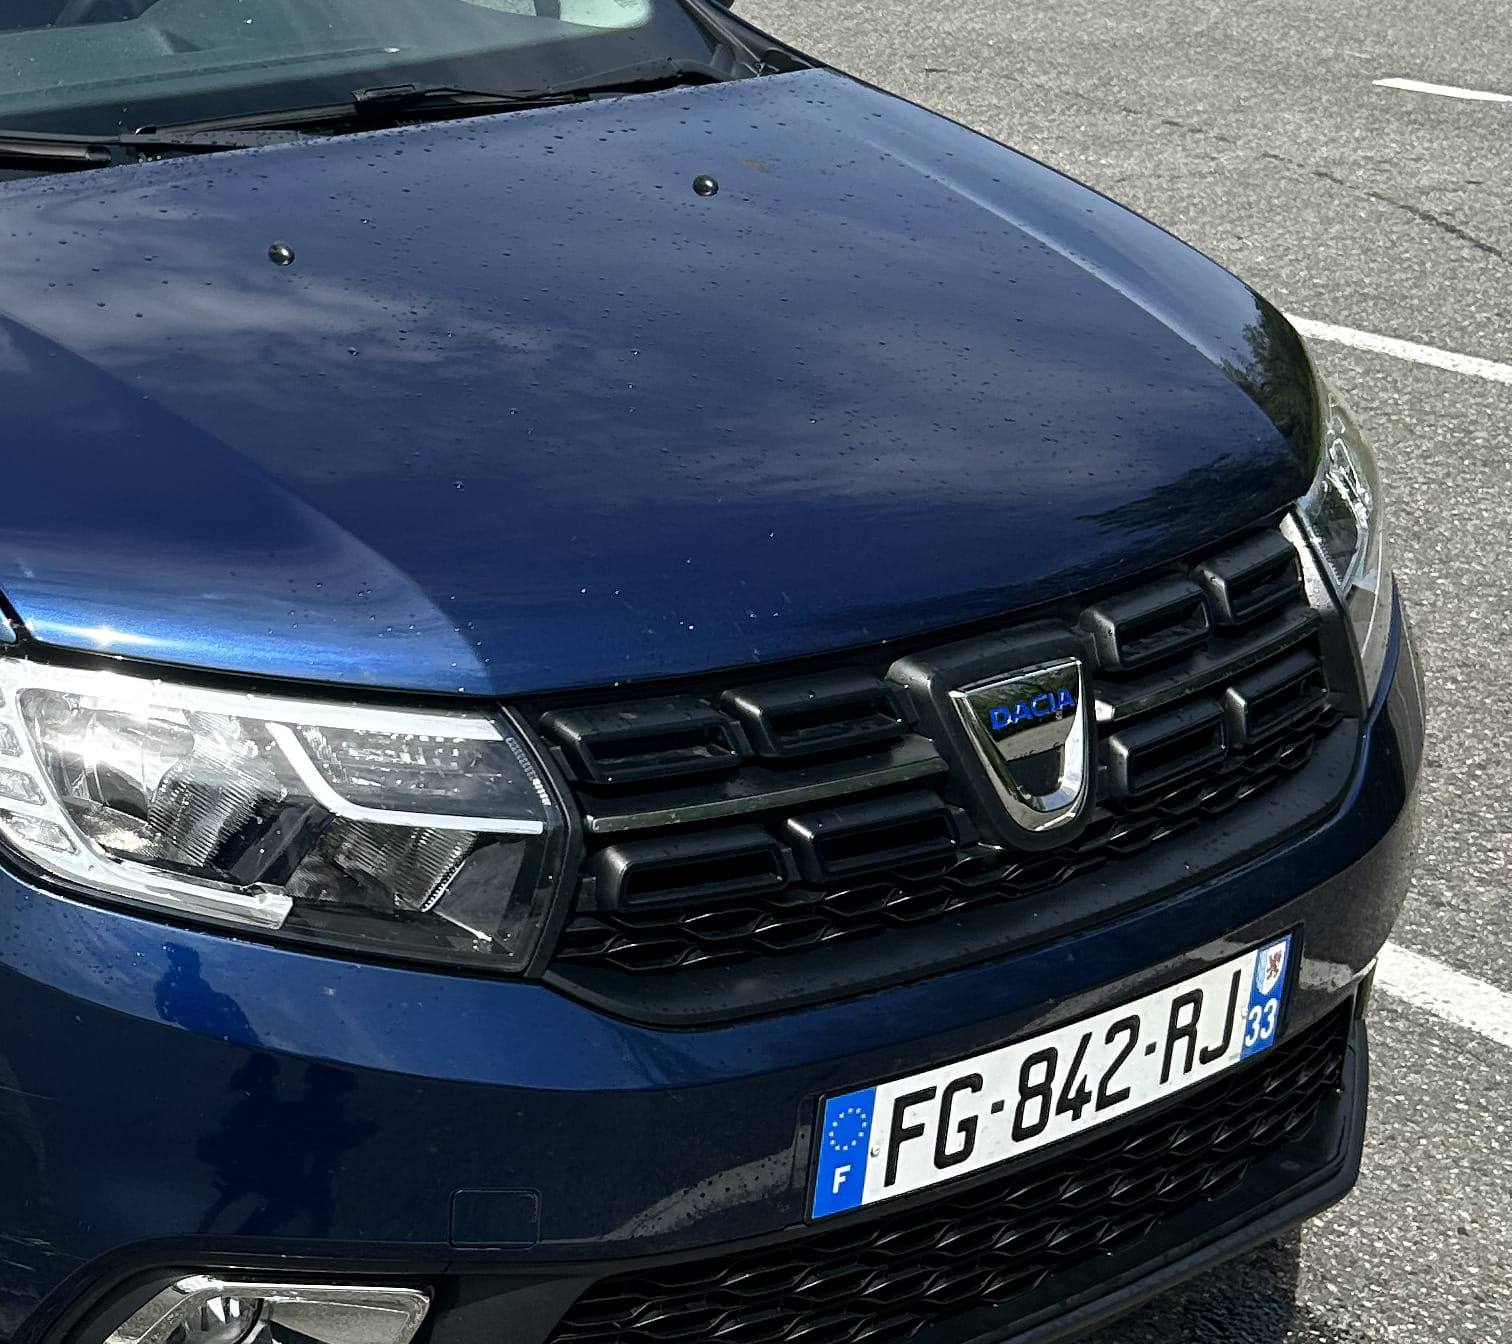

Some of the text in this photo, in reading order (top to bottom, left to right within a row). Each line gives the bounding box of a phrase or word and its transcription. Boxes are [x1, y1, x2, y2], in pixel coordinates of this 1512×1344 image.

[989, 688, 1076, 729] DACIA
[832, 969, 1278, 1194] F FG-842-RJ 33
